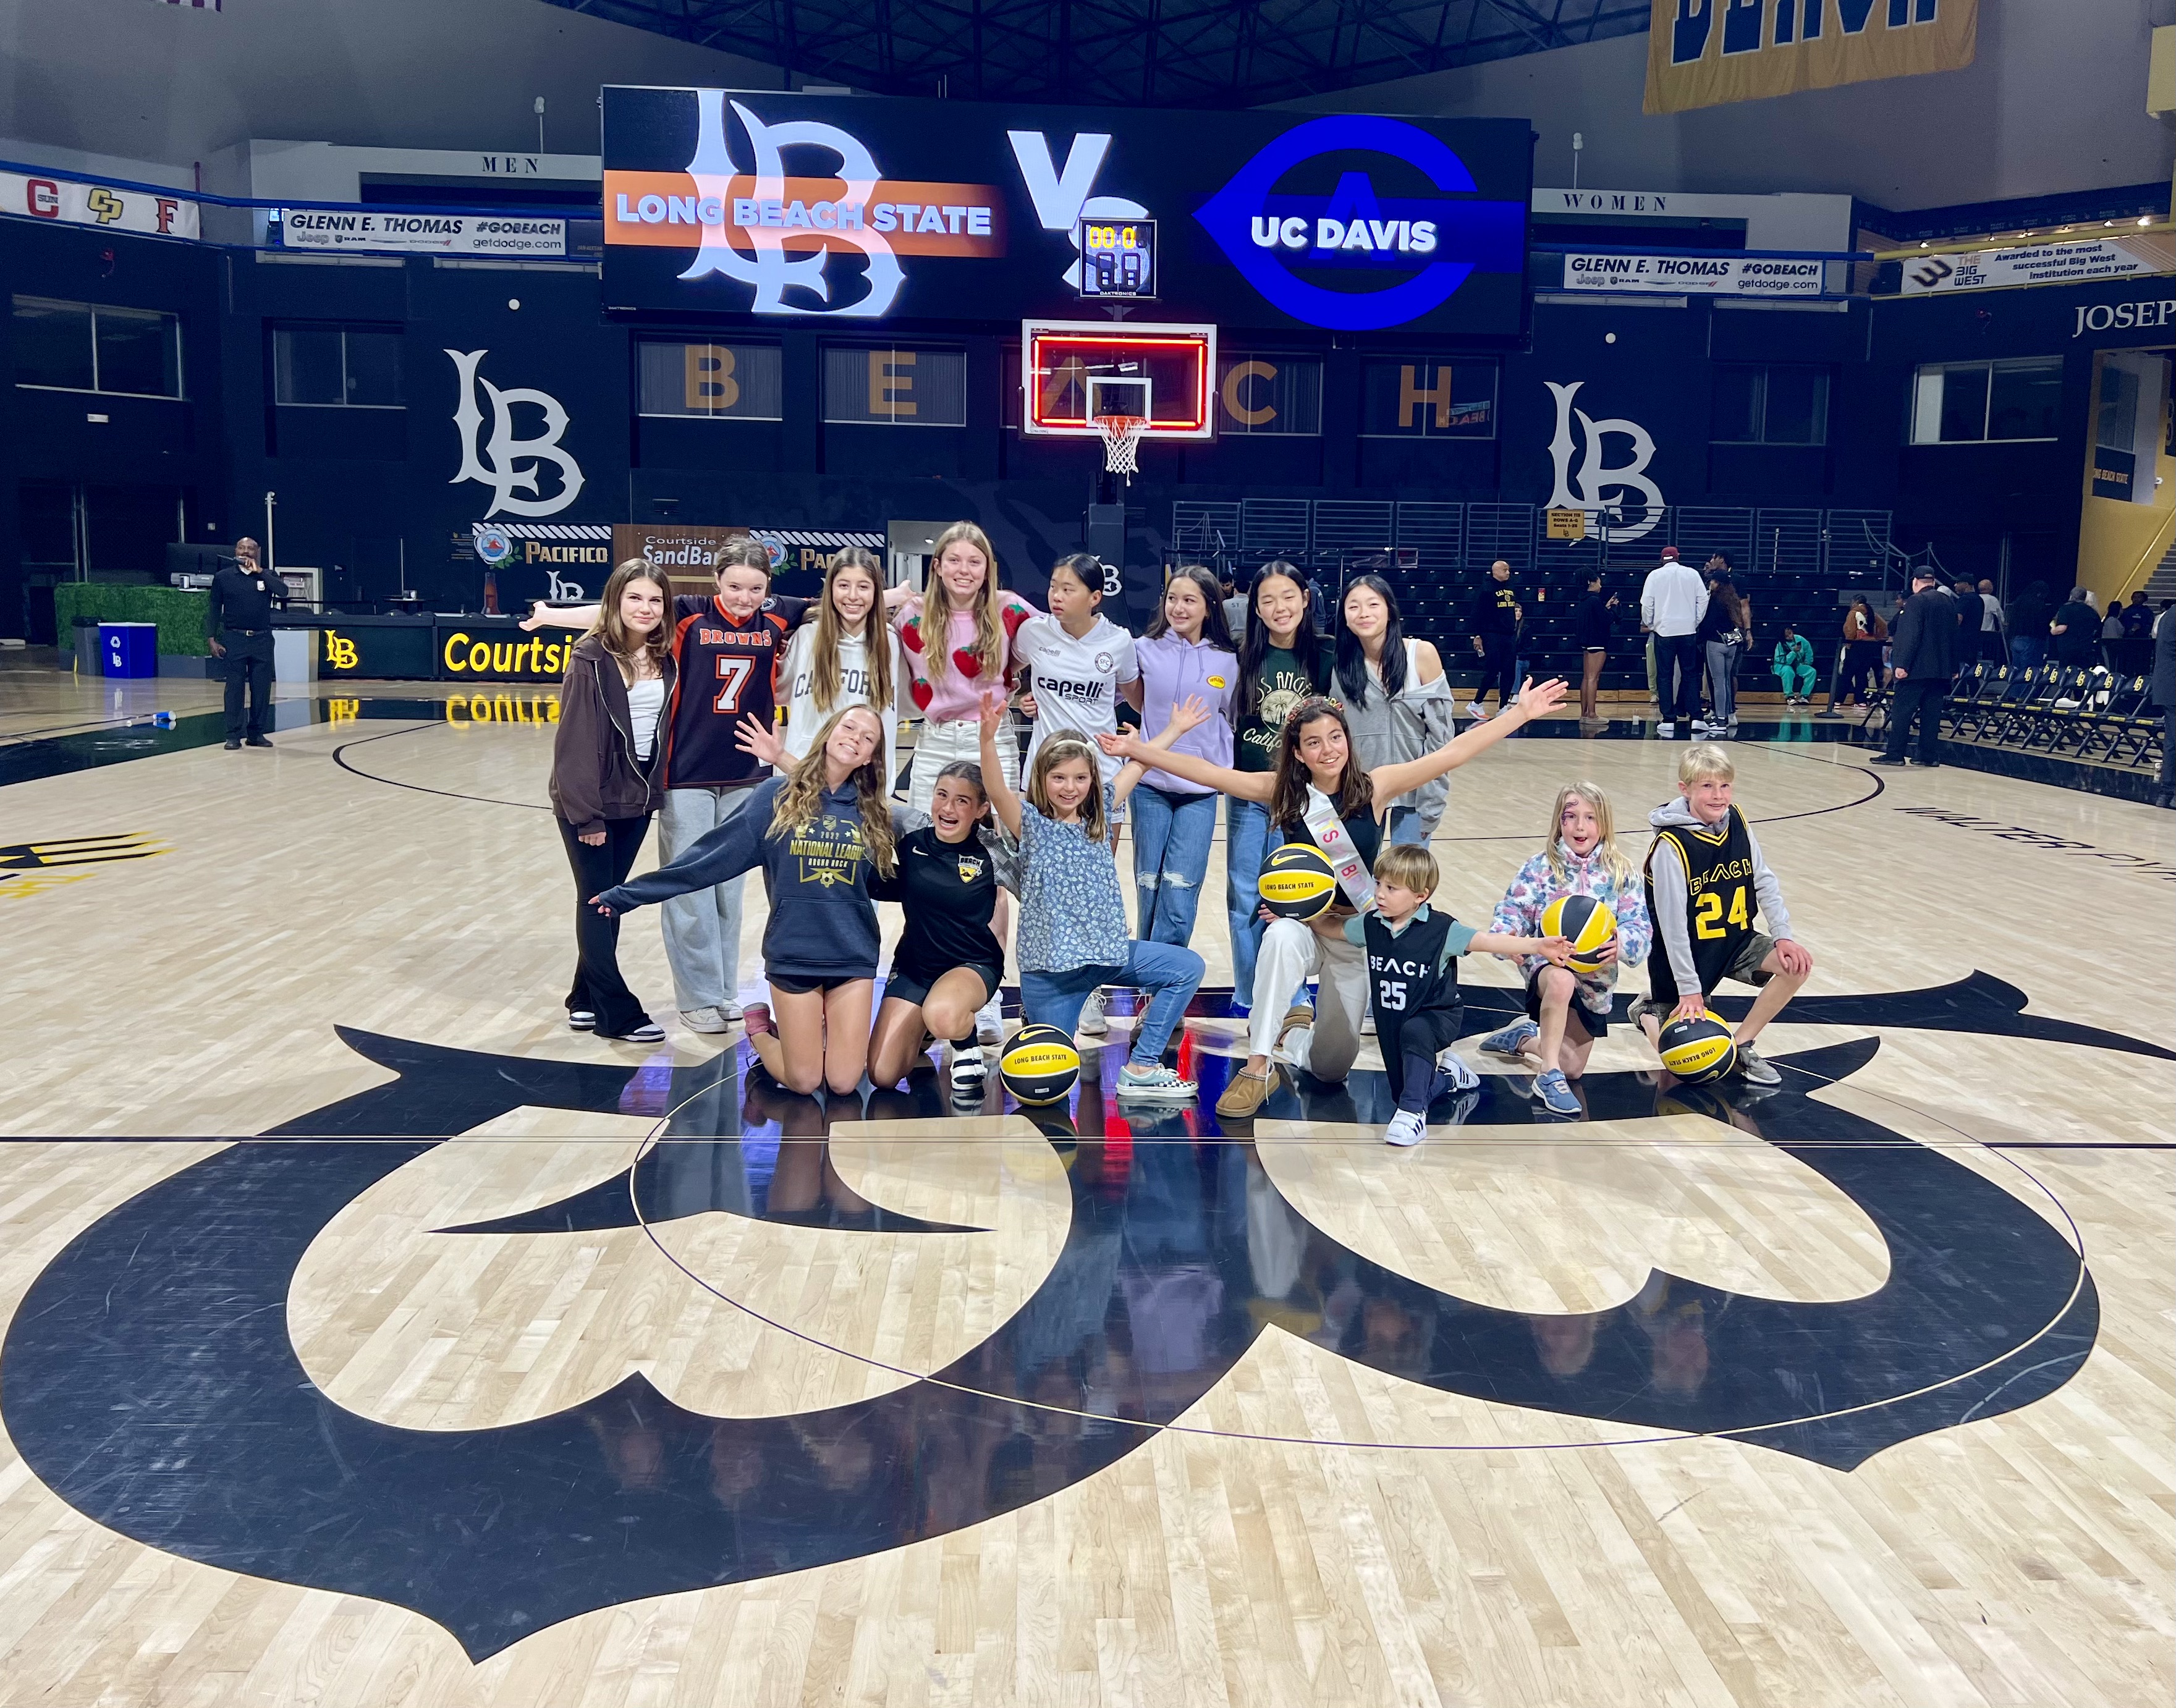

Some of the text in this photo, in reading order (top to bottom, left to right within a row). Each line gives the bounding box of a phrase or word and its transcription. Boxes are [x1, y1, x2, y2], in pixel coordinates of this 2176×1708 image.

[481, 156, 540, 174] MEN
[1563, 193, 1668, 212] WOMEN
[155, 198, 179, 234] F
[617, 193, 993, 235] LONG BEACH STATE
[290, 214, 561, 235] GLENN E. THOMAS #GOBEACH
[297, 231, 329, 245] Jeep
[1251, 216, 1437, 252] UC DAVIS
[473, 237, 562, 250] getdodge.com
[1958, 255, 1981, 266] THE
[1994, 244, 2102, 262] Awarded to the most
[2012, 253, 2116, 271] successful Big West
[1571, 258, 1818, 276] GLENN E. THOMAS #GOBEACH
[1956, 266, 1978, 276] BIG
[2029, 263, 2138, 279] institution each year
[1576, 274, 1605, 287] Jeep
[1738, 279, 1818, 290] getdodge.com
[1954, 274, 1987, 286] WEST
[645, 536, 716, 546] Courtside
[700, 628, 773, 647] BROWNS
[445, 633, 572, 674] Courtsi
[713, 654, 756, 714] 7
[1038, 677, 1104, 698] capelli
[1064, 693, 1099, 704] SPORT
[1243, 728, 1282, 753] Califo
[789, 840, 833, 858] NATIONAL
[1690, 858, 1752, 895] BEACH
[1695, 886, 1748, 940] 24
[1370, 955, 1431, 978] BEACH
[1379, 979, 1407, 1011] 25
[1015, 1057, 1029, 1065] LONG
[1682, 1054, 1700, 1063] BEACH
[1701, 1047, 1716, 1057] LONG
